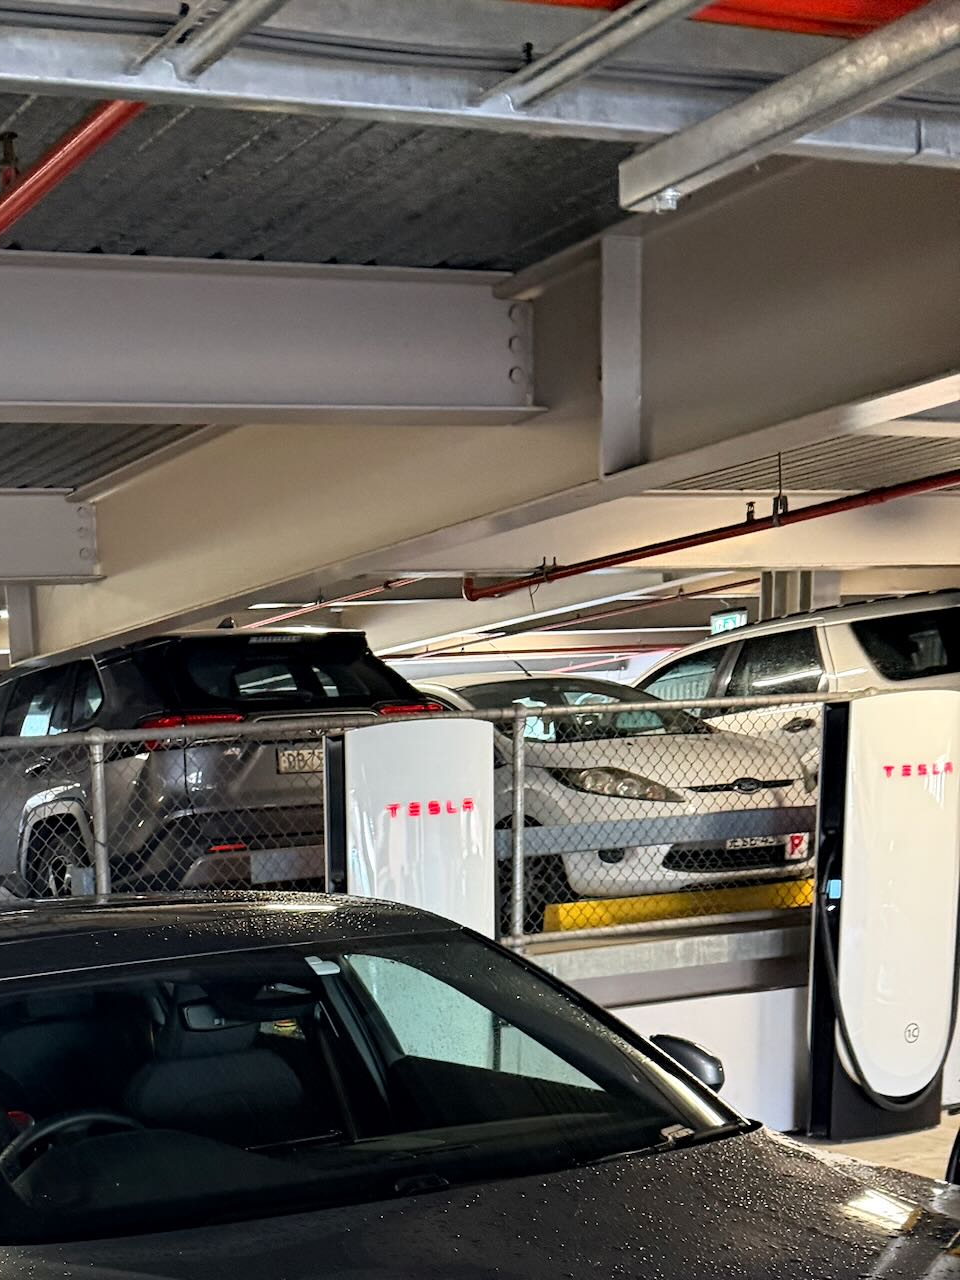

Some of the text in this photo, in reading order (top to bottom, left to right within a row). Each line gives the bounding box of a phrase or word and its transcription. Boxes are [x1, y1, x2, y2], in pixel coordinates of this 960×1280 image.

[883, 761, 954, 778] TESLA
[385, 798, 474, 818] TESLA
[789, 835, 804, 856] P
